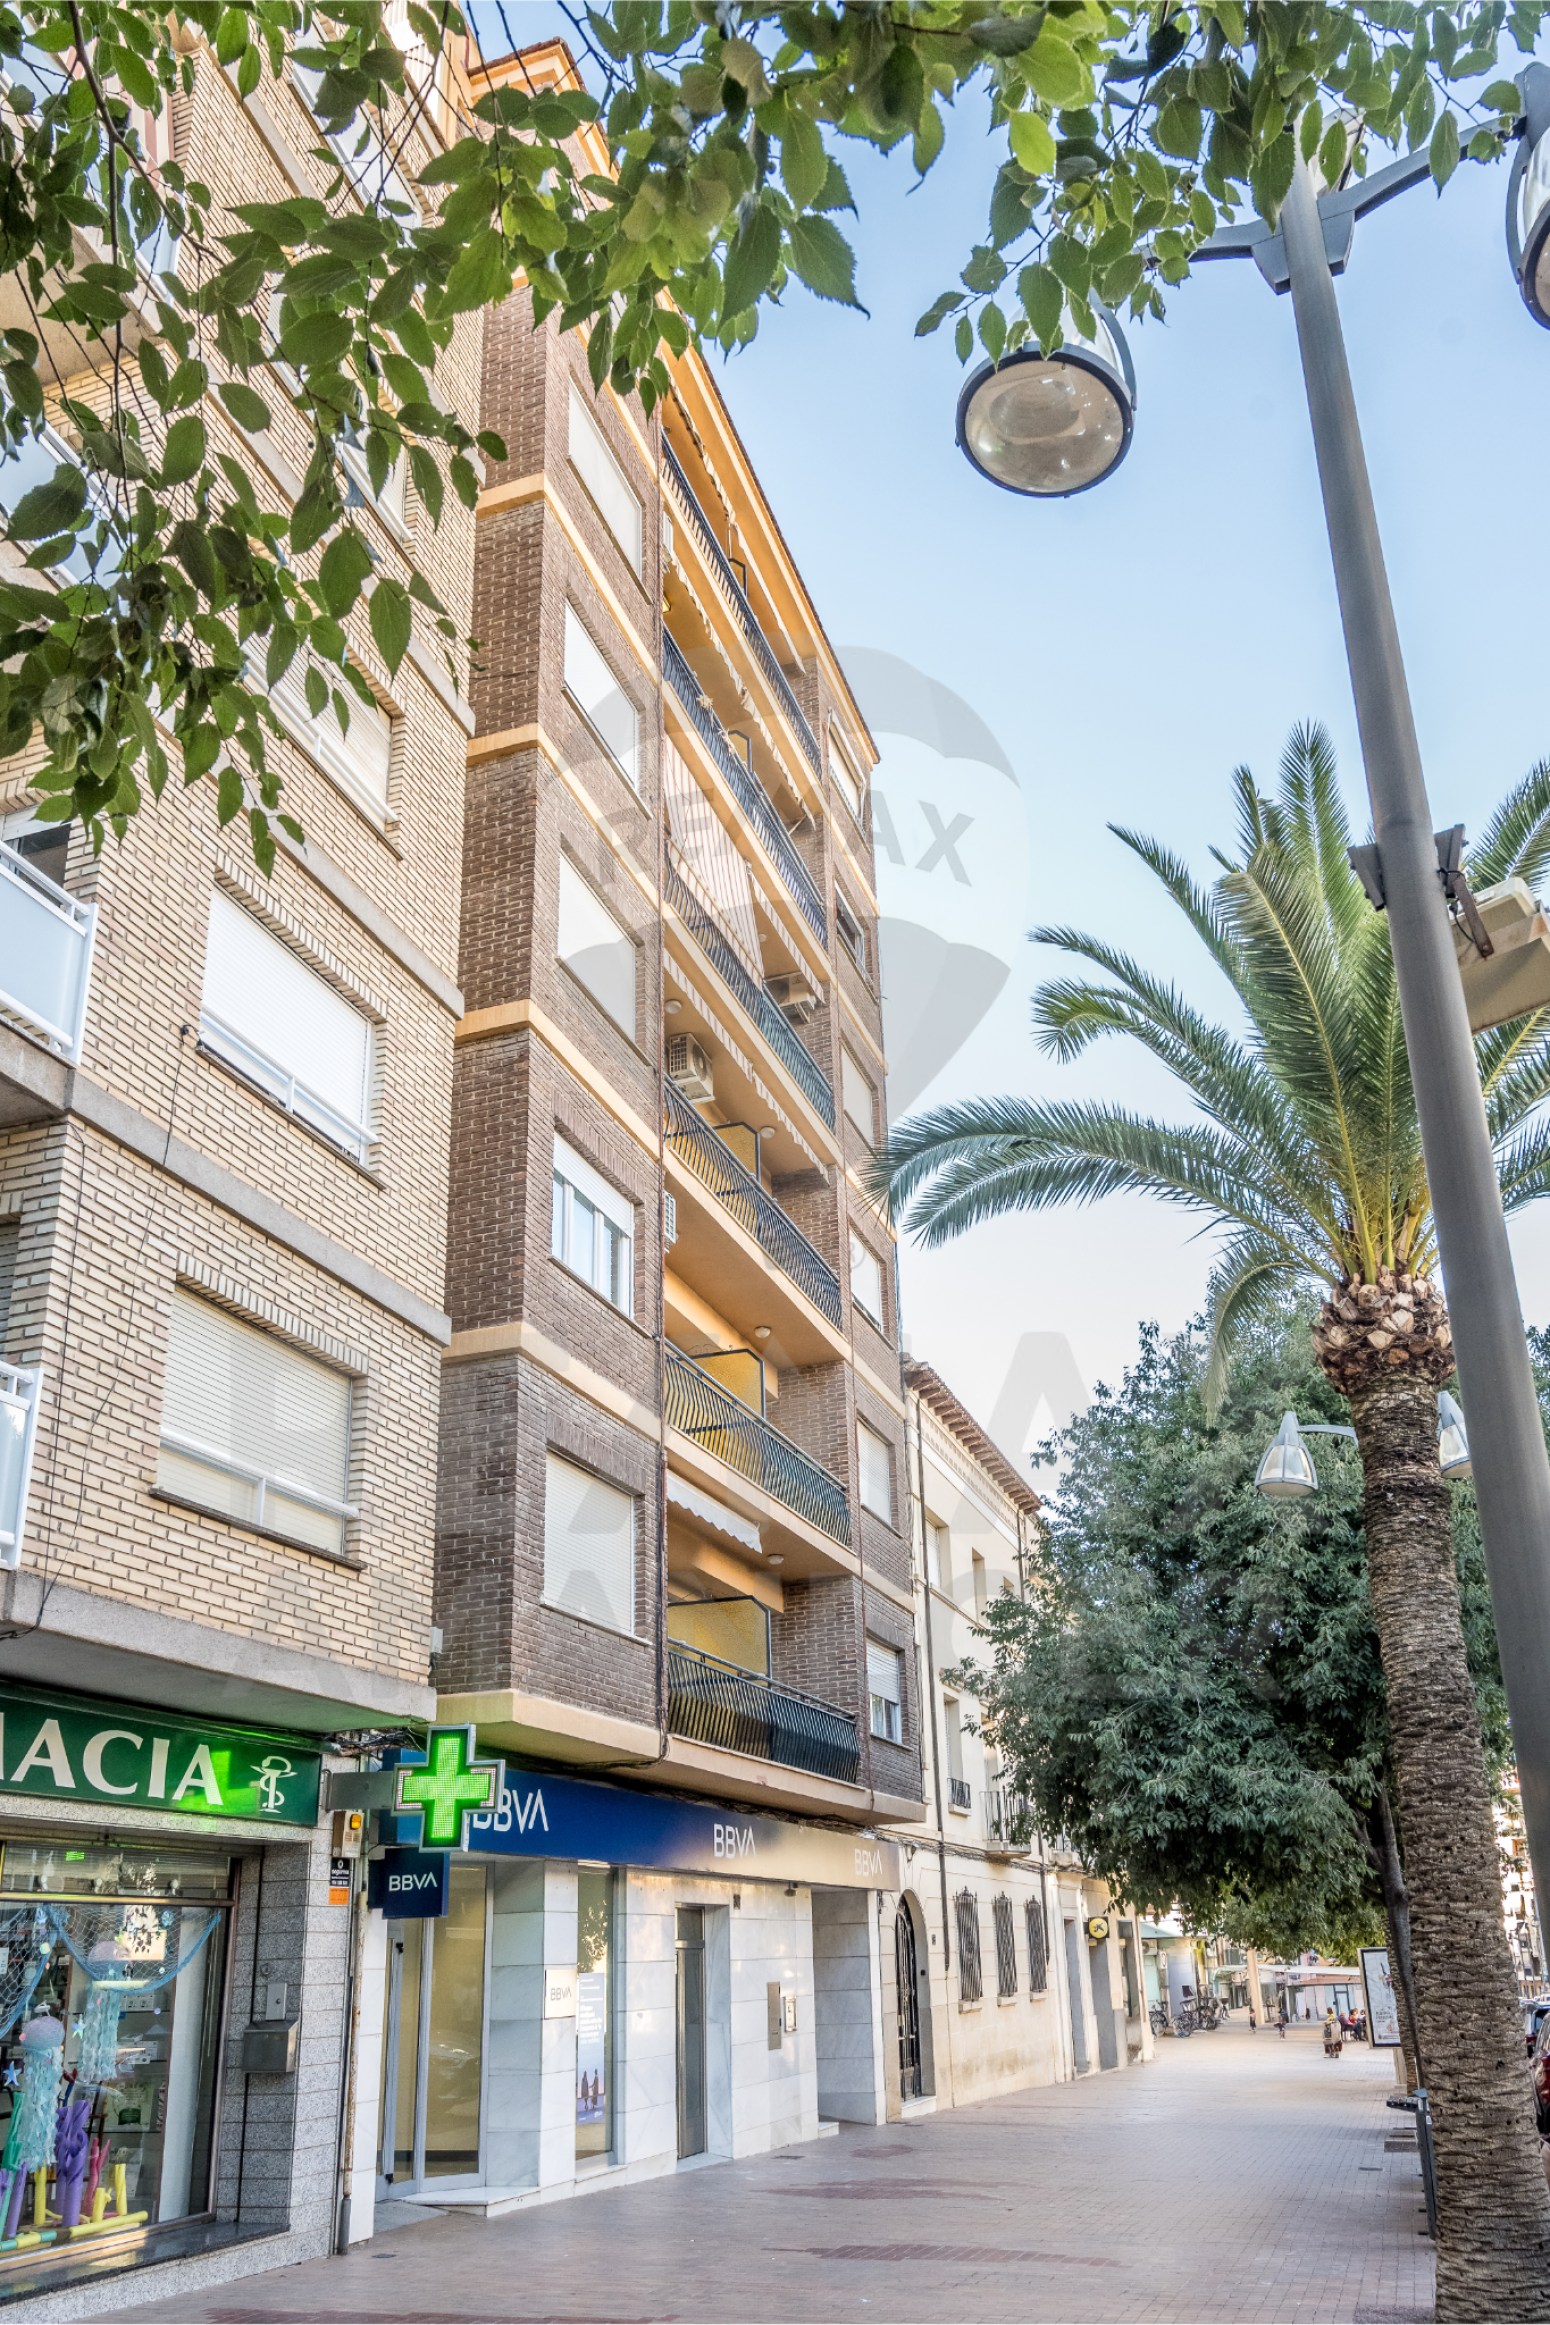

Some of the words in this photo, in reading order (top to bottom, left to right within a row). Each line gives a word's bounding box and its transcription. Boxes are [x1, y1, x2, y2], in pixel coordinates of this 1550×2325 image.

[0, 1711, 224, 1806] ACIA
[714, 1823, 756, 1859] BBVA
[855, 1848, 883, 1877] BBVA
[388, 1871, 438, 1892] BBVA
[550, 1986, 572, 2001] BBVA
